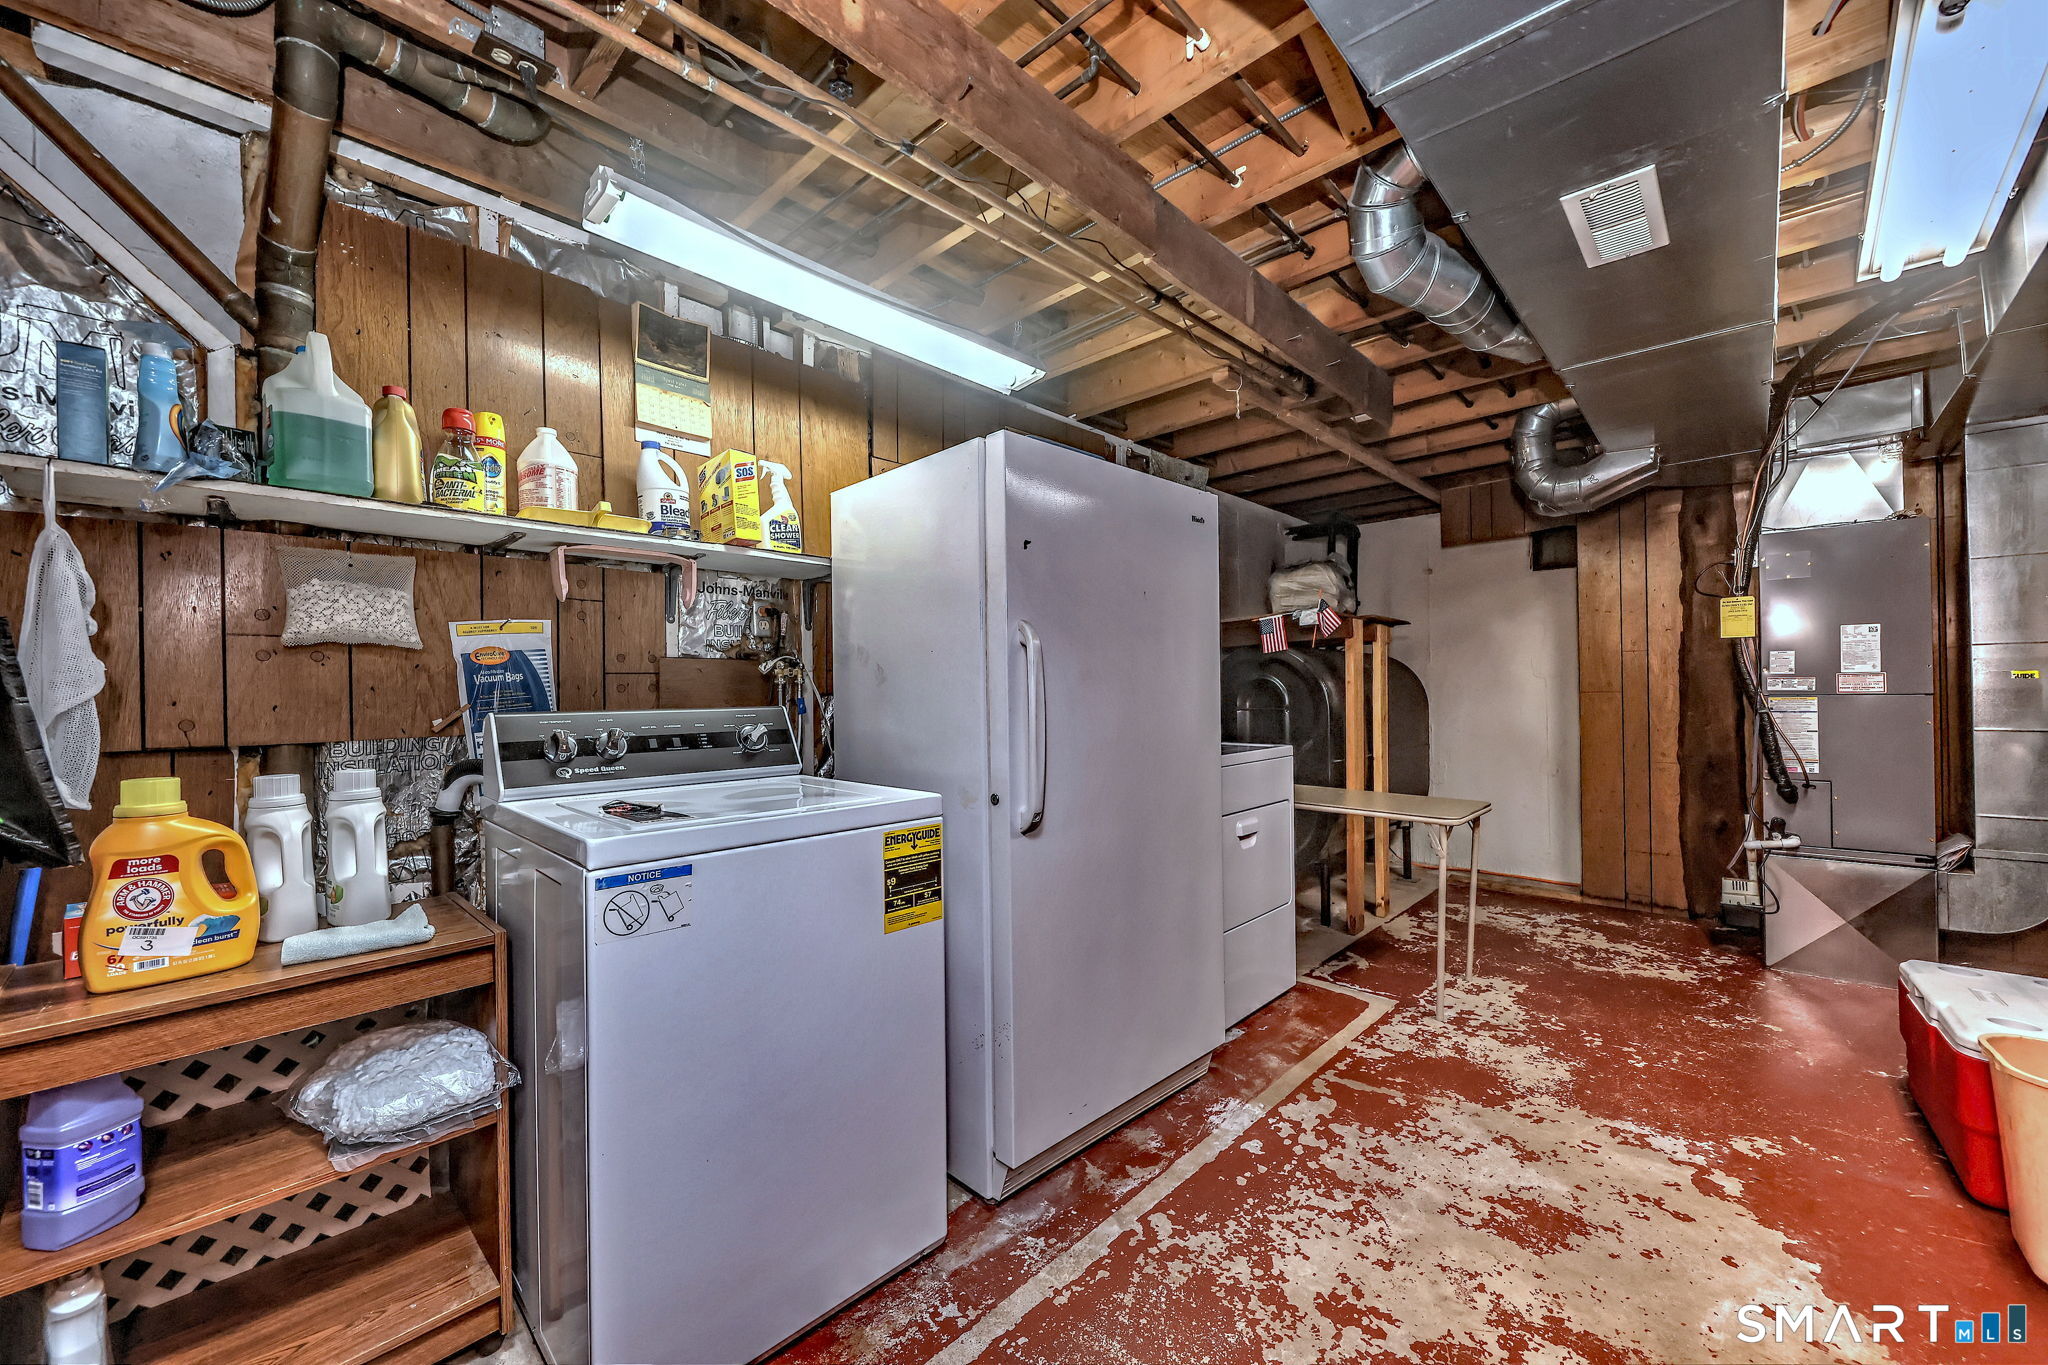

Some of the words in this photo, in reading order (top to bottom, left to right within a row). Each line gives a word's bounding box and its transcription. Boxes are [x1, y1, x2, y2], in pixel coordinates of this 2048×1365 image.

[434, 470, 478, 484] GREEN
[735, 467, 754, 478] SOS
[444, 480, 468, 489] ANTI-
[436, 489, 476, 499] BACTERIAL
[770, 524, 799, 532] CLEAN
[770, 532, 800, 540] SHOWER
[473, 673, 505, 684] Vacuum
[505, 671, 524, 682] Bags
[574, 766, 600, 774] Speed
[884, 827, 941, 846] ENERGYGUIDE
[127, 857, 161, 866] more
[127, 864, 163, 874] loads
[627, 870, 662, 882] NOTICE
[886, 877, 897, 886] $9
[117, 889, 130, 907] ARM
[137, 879, 171, 900] HAMMER
[924, 891, 932, 899] $7
[140, 940, 153, 951] 3
